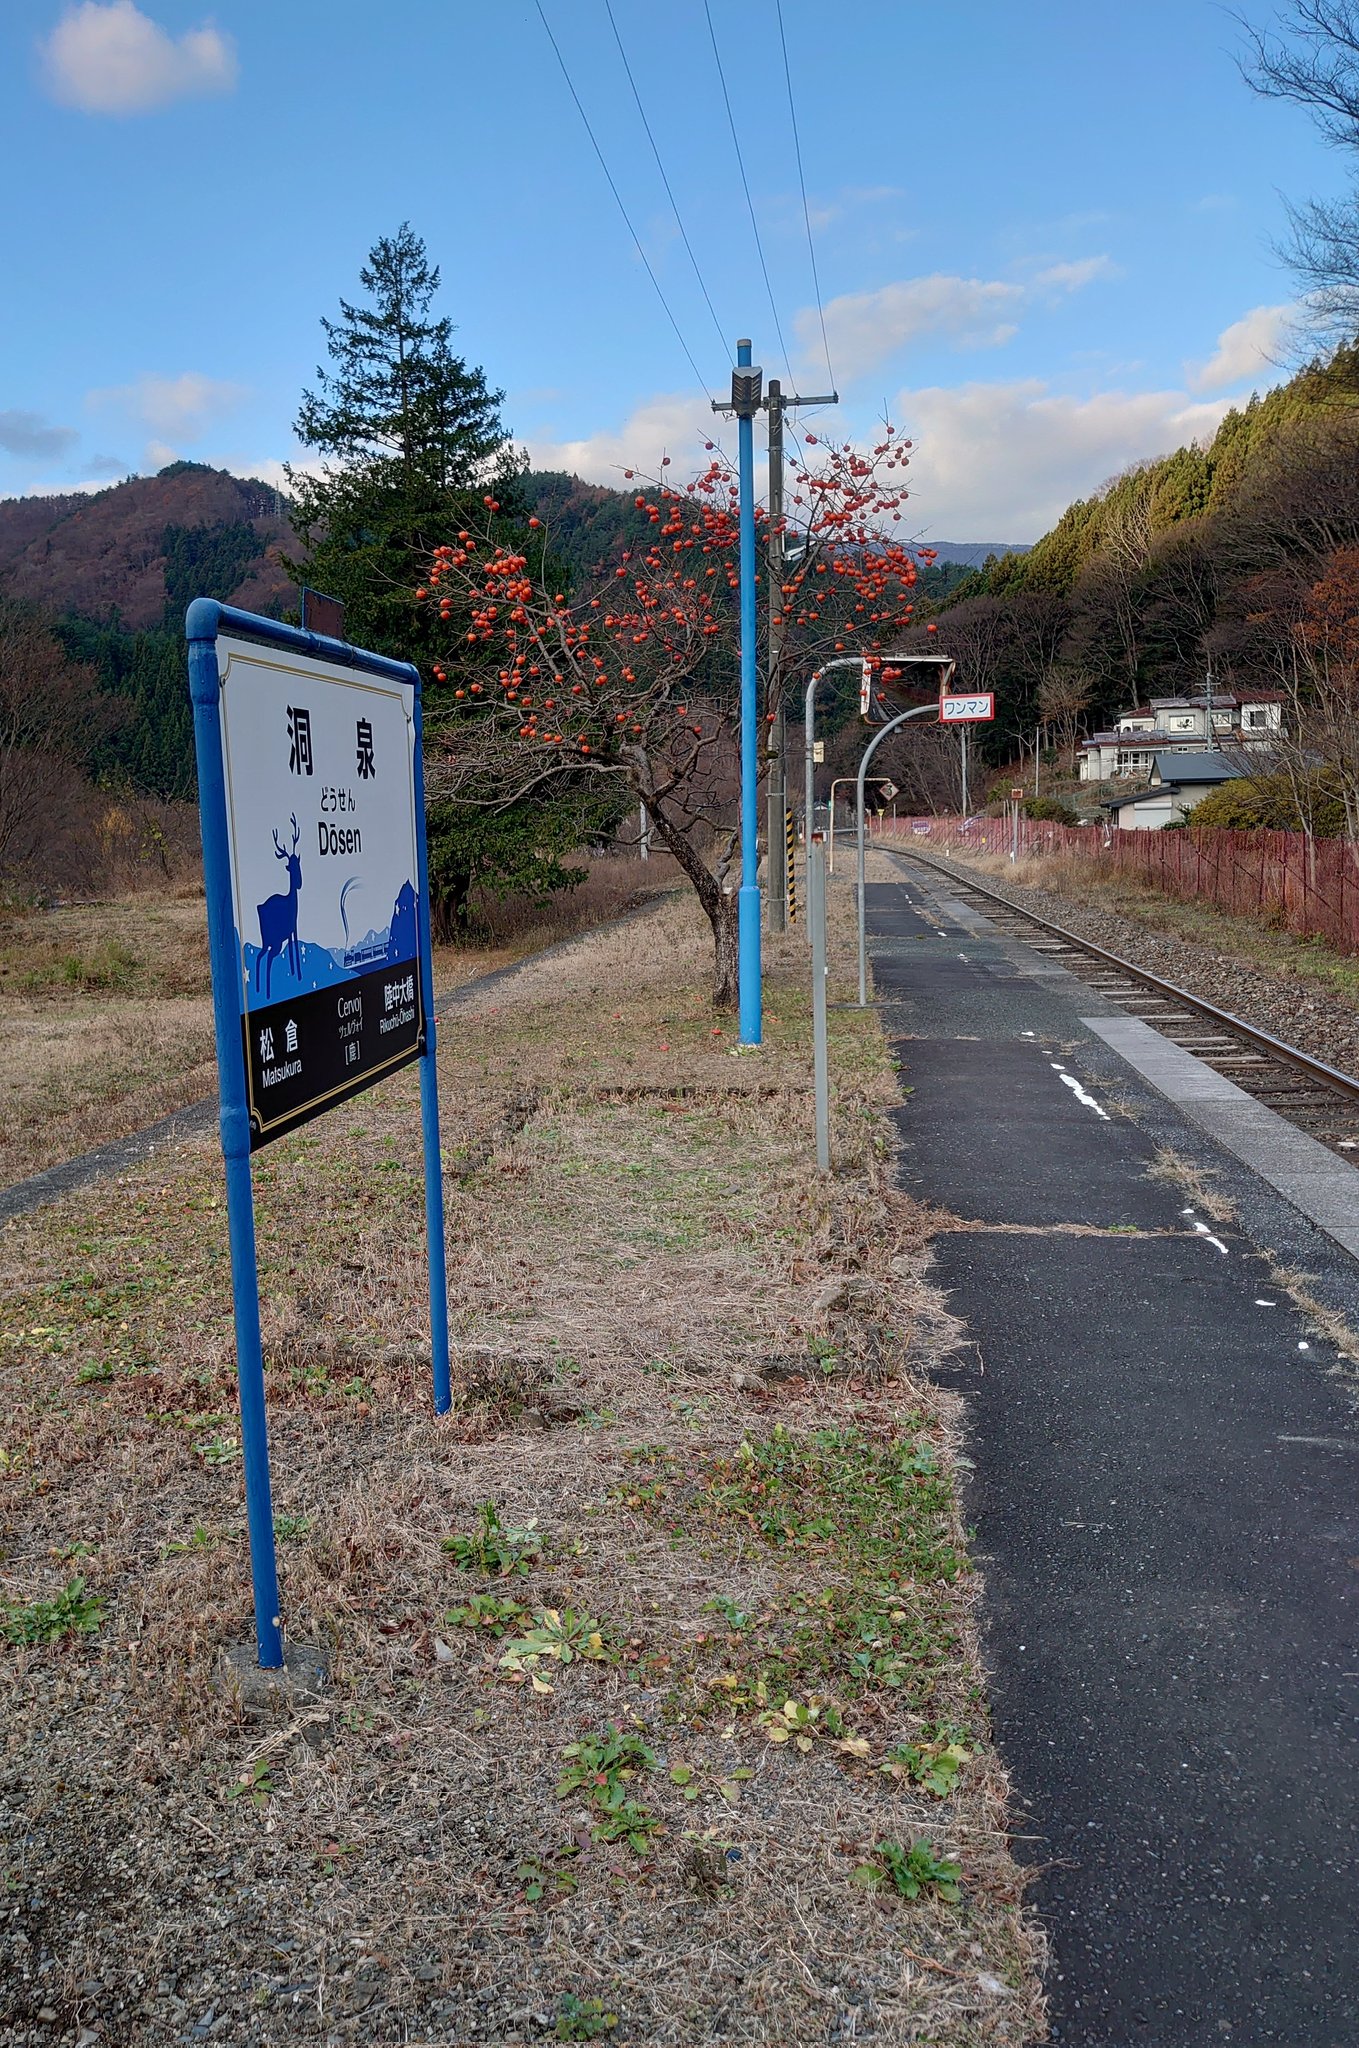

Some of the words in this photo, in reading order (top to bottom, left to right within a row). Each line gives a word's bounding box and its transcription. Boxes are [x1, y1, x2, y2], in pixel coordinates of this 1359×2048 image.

[944, 701, 989, 716] ワンマン
[320, 786, 356, 812] どうせん
[317, 821, 362, 856] Dōsen
[337, 990, 362, 1018] Cervoj
[384, 974, 414, 1012] 陸中大橋
[262, 1059, 302, 1089] Matsukura
